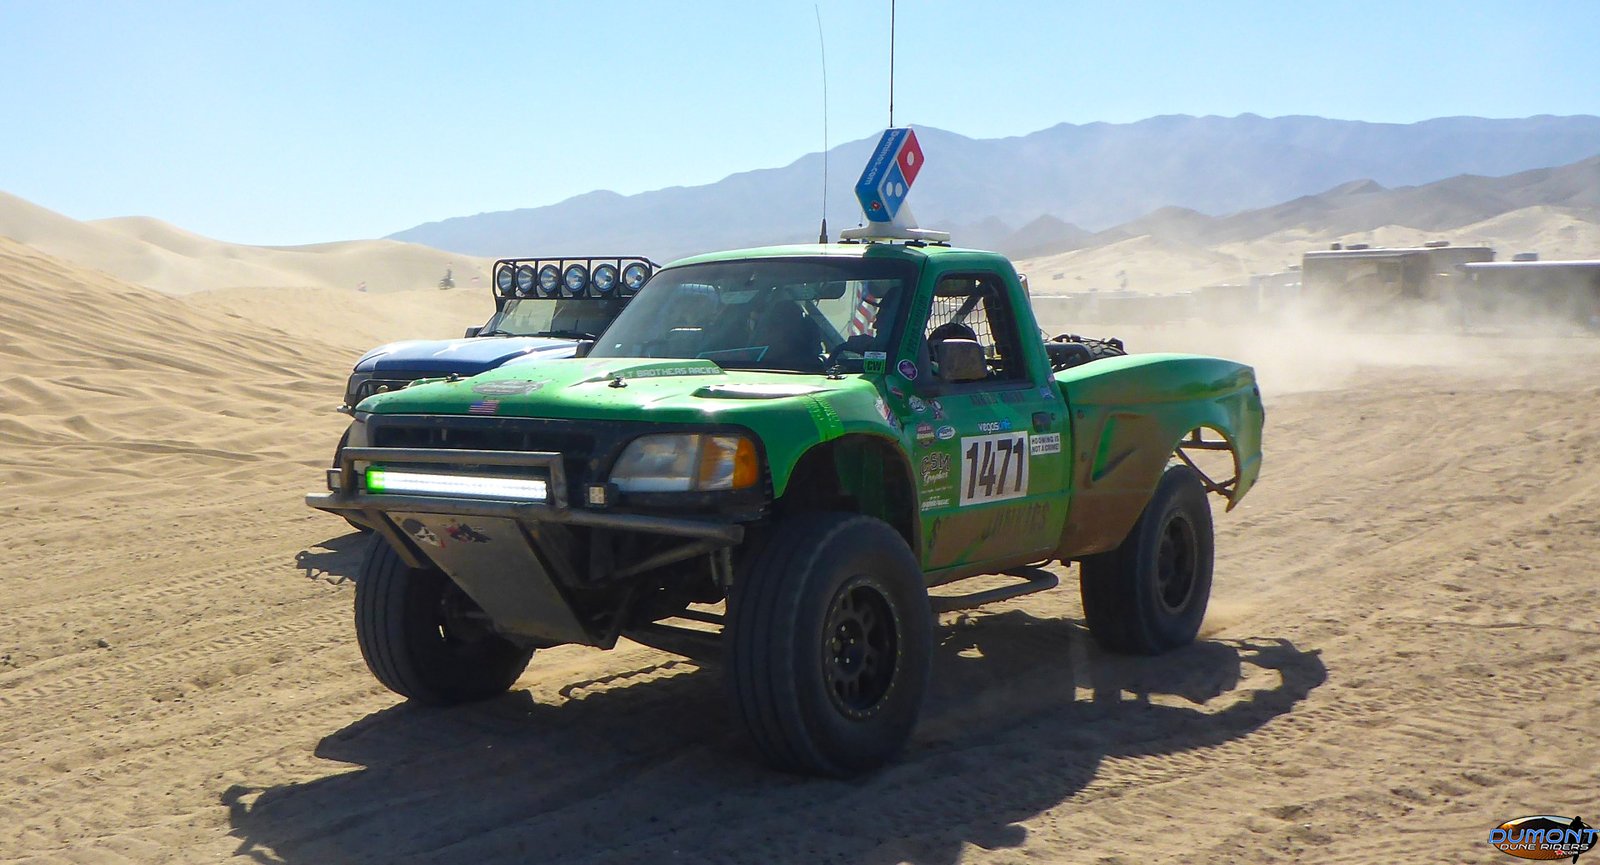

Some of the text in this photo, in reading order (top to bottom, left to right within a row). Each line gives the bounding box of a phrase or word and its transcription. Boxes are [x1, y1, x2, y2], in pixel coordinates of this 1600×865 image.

[637, 367, 687, 377] BROTHERS
[688, 366, 720, 375] RACING
[966, 438, 1024, 497] 1471
